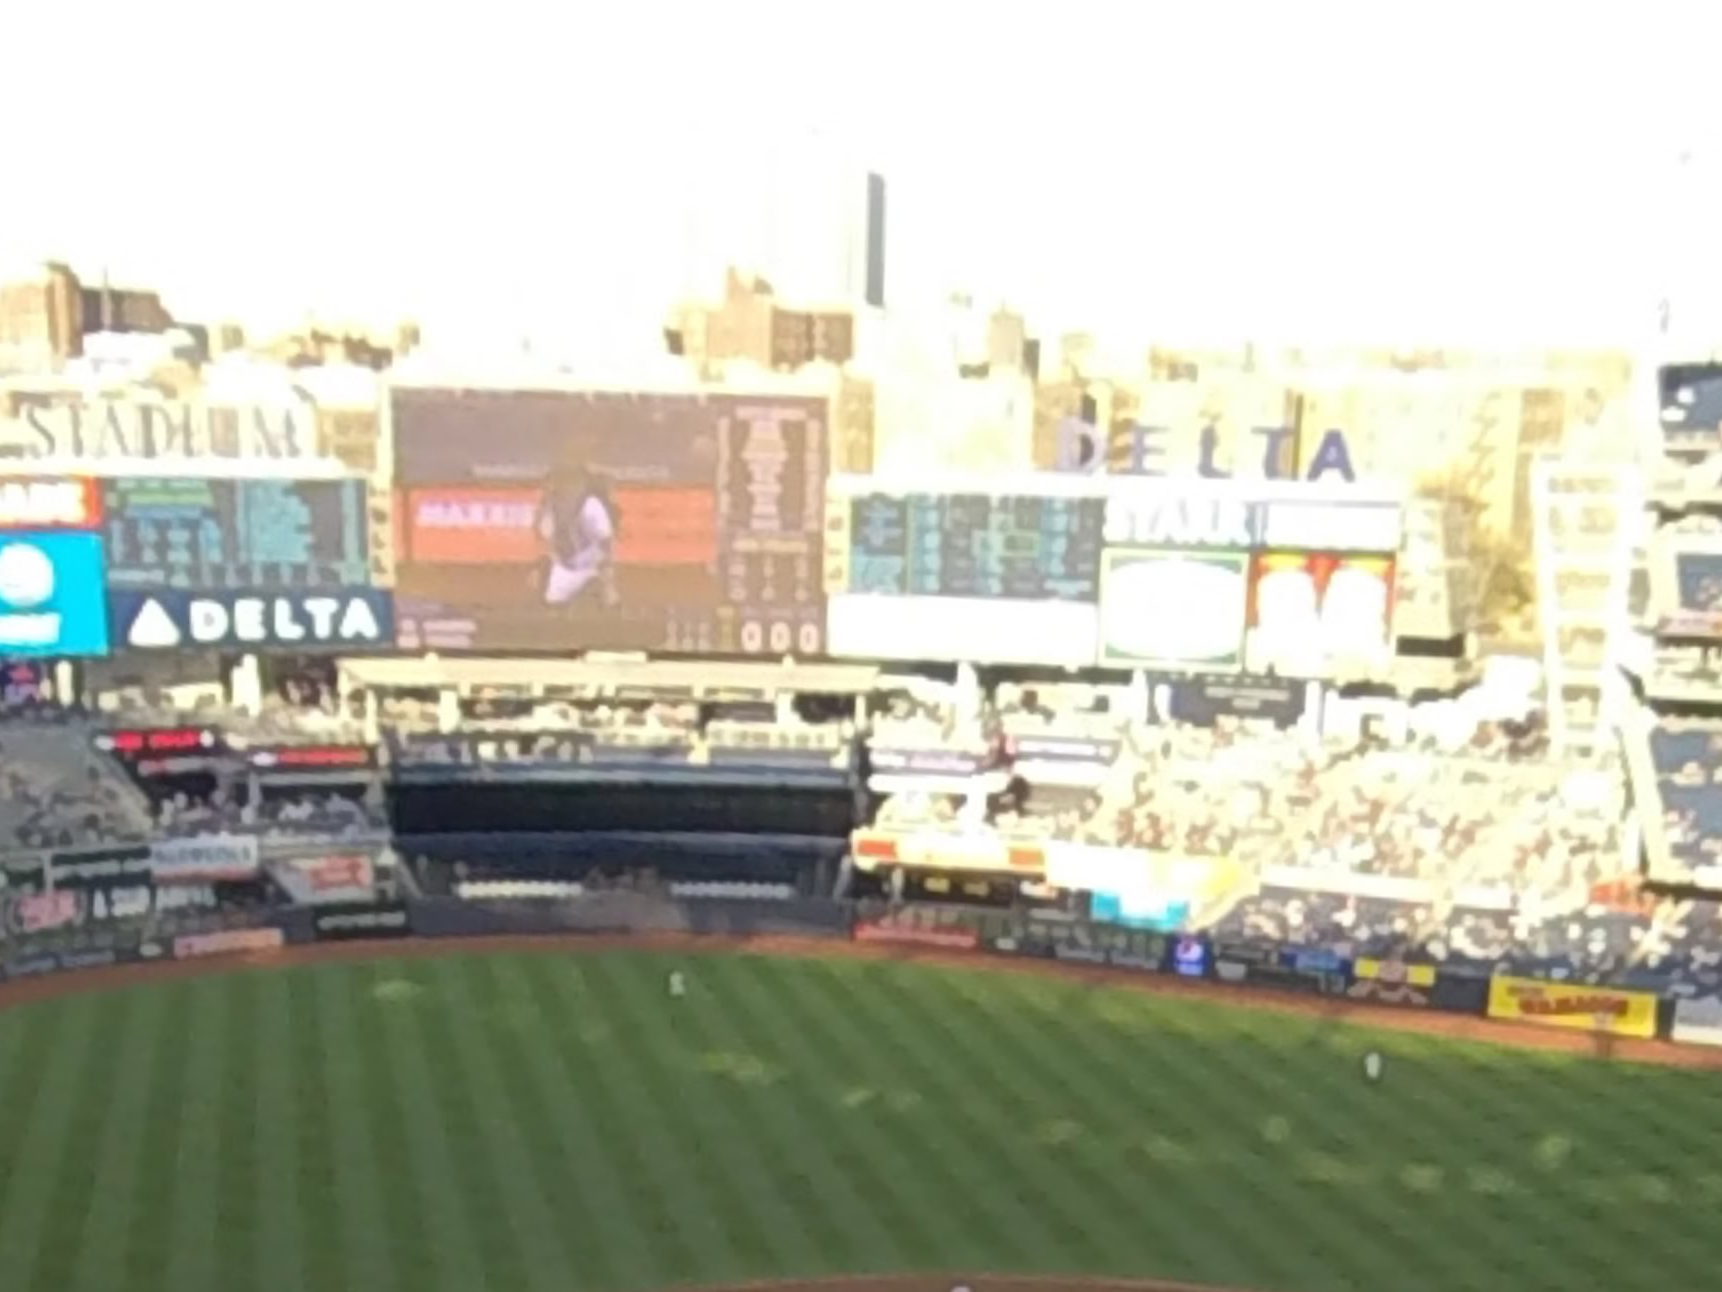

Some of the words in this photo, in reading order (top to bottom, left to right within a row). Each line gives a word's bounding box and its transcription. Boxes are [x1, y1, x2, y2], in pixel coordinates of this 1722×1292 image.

[21, 398, 301, 458] STADIUM
[1058, 420, 1355, 483] DELTA
[189, 597, 380, 642] DELTA
[741, 621, 762, 652] 0
[770, 621, 791, 652] 0
[799, 622, 820, 653] 0
